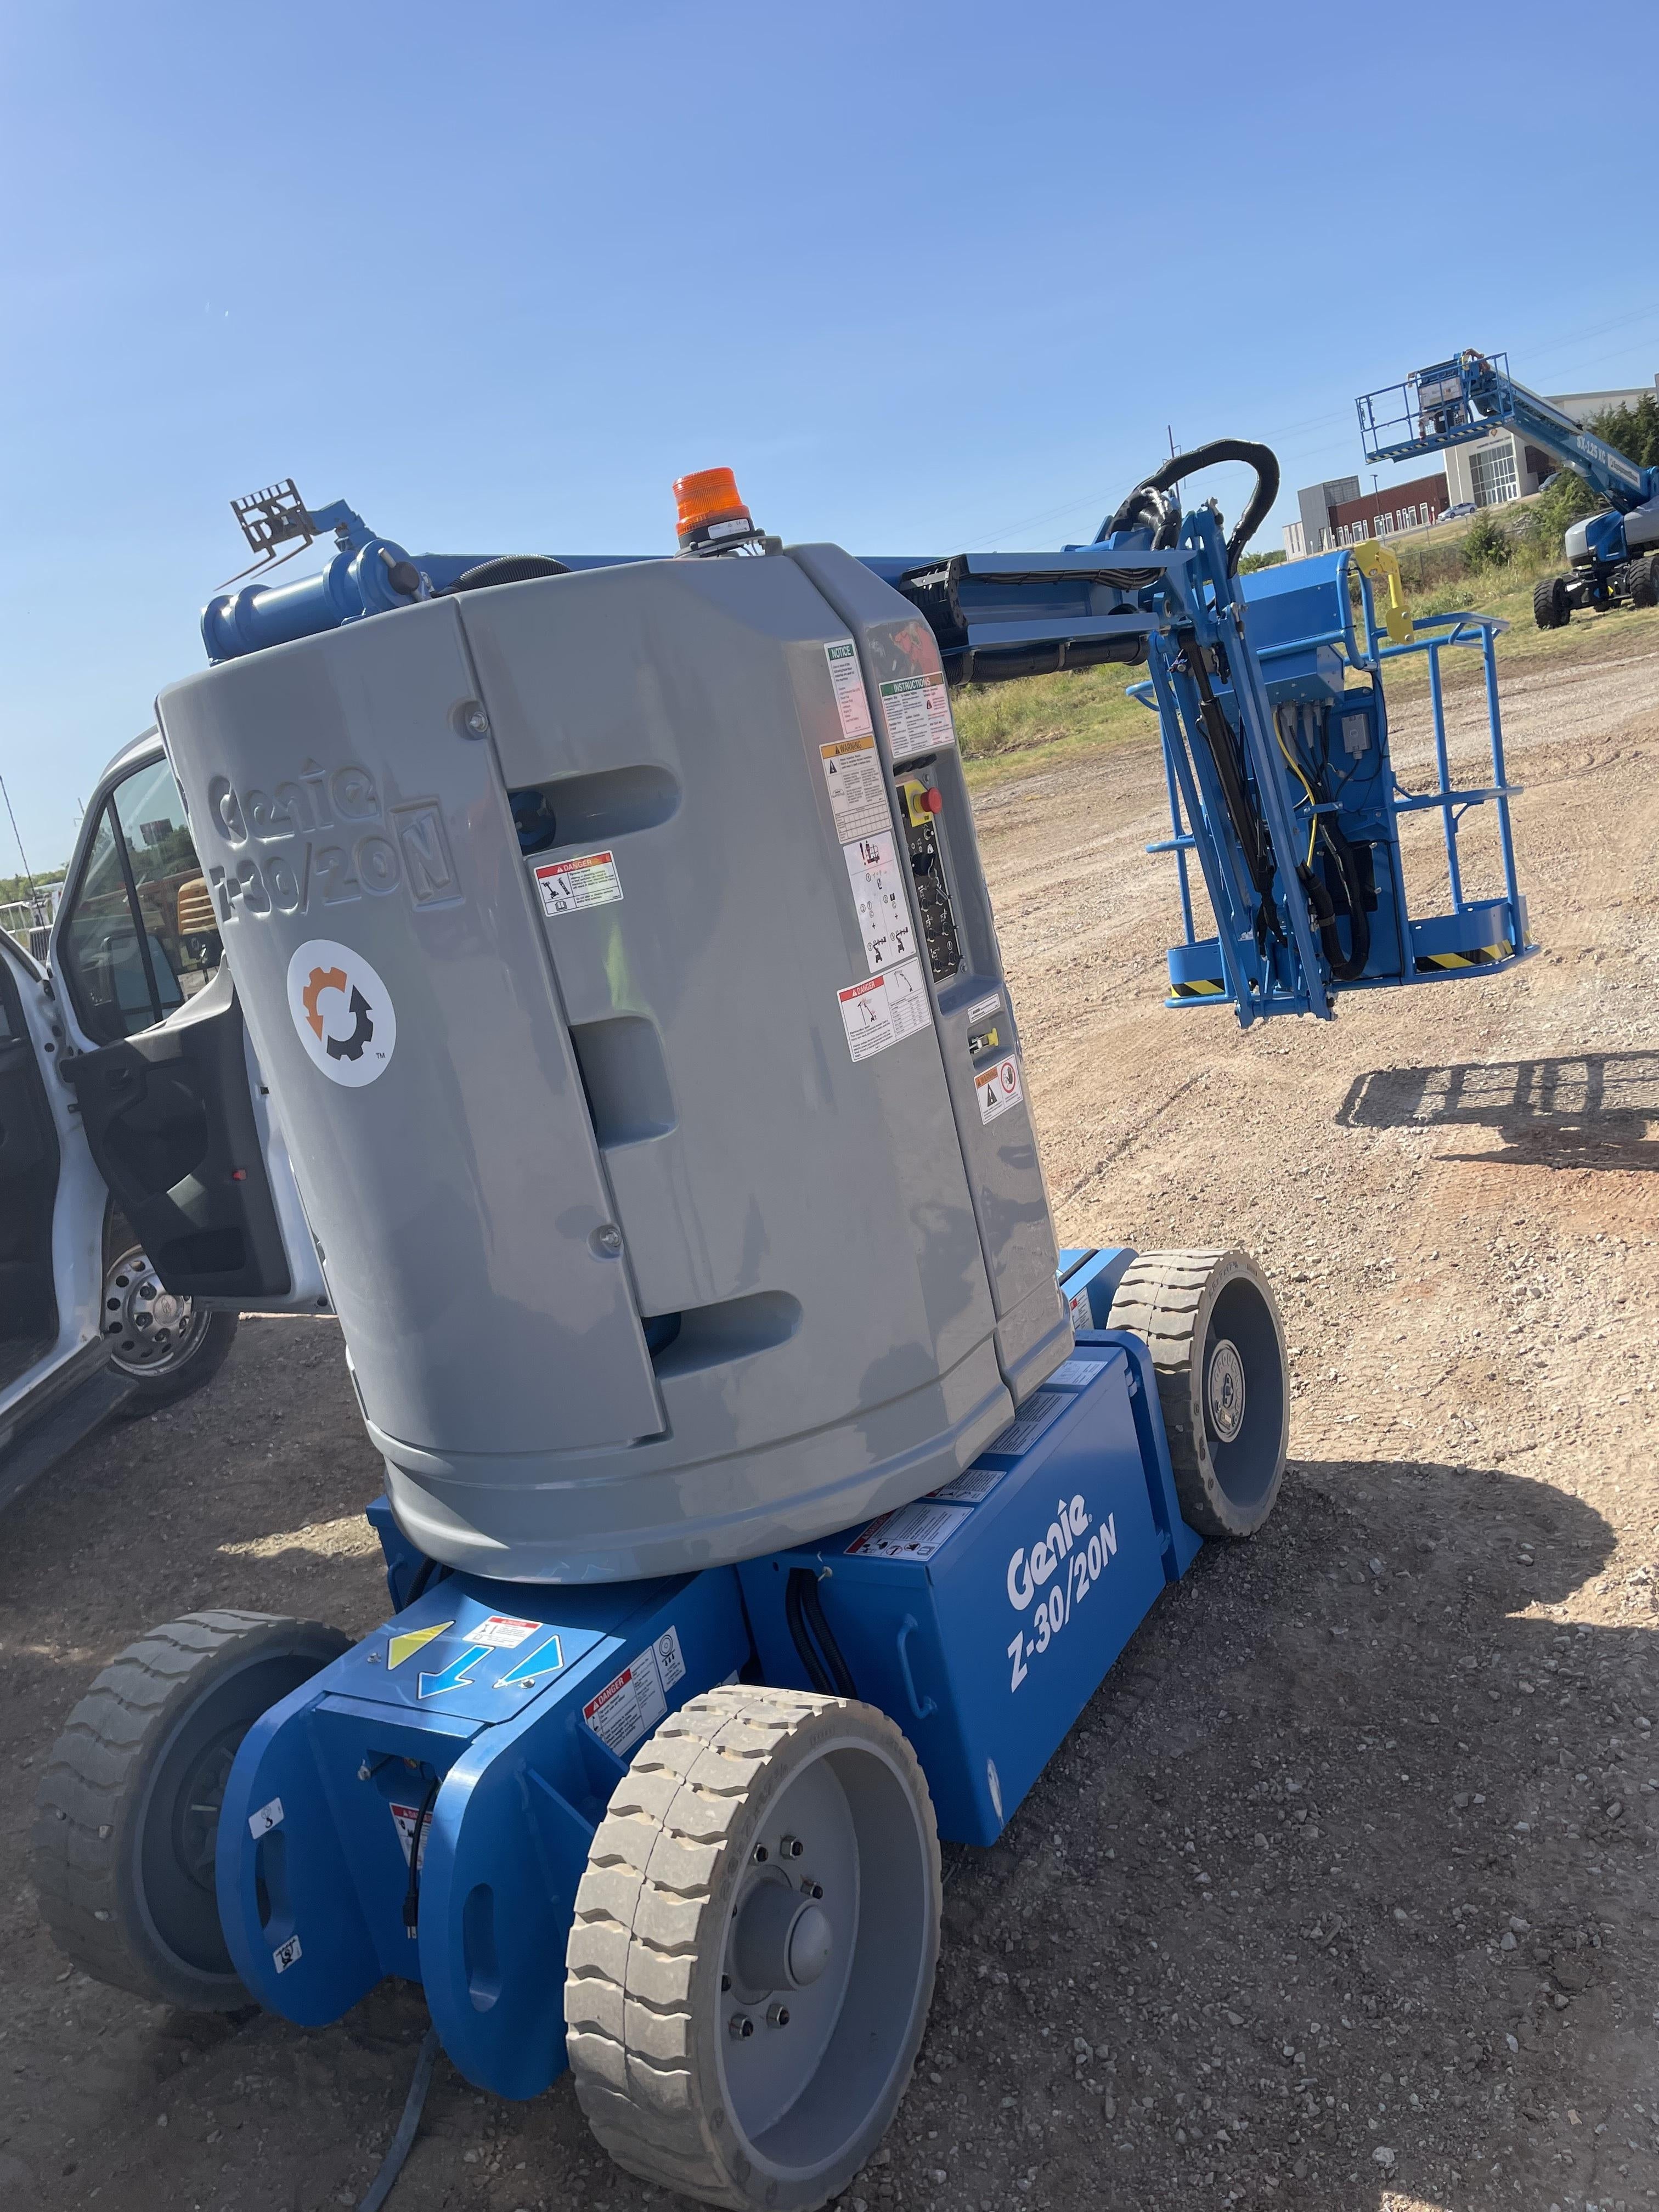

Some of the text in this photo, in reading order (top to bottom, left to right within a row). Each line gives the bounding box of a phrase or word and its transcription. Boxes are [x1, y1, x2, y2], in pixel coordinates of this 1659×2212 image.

[831, 646, 851, 658] NOTICE
[893, 677, 931, 692] INSTRUCTIONS
[839, 741, 862, 753] WARNING
[208, 758, 382, 850] Genie
[563, 859, 592, 871] DANGER
[856, 980, 876, 995] DANGER
[1007, 1494, 1089, 1611] Genie
[1007, 1512, 1118, 1694] Z-30/20N
[599, 1677, 624, 1704] DANGER
